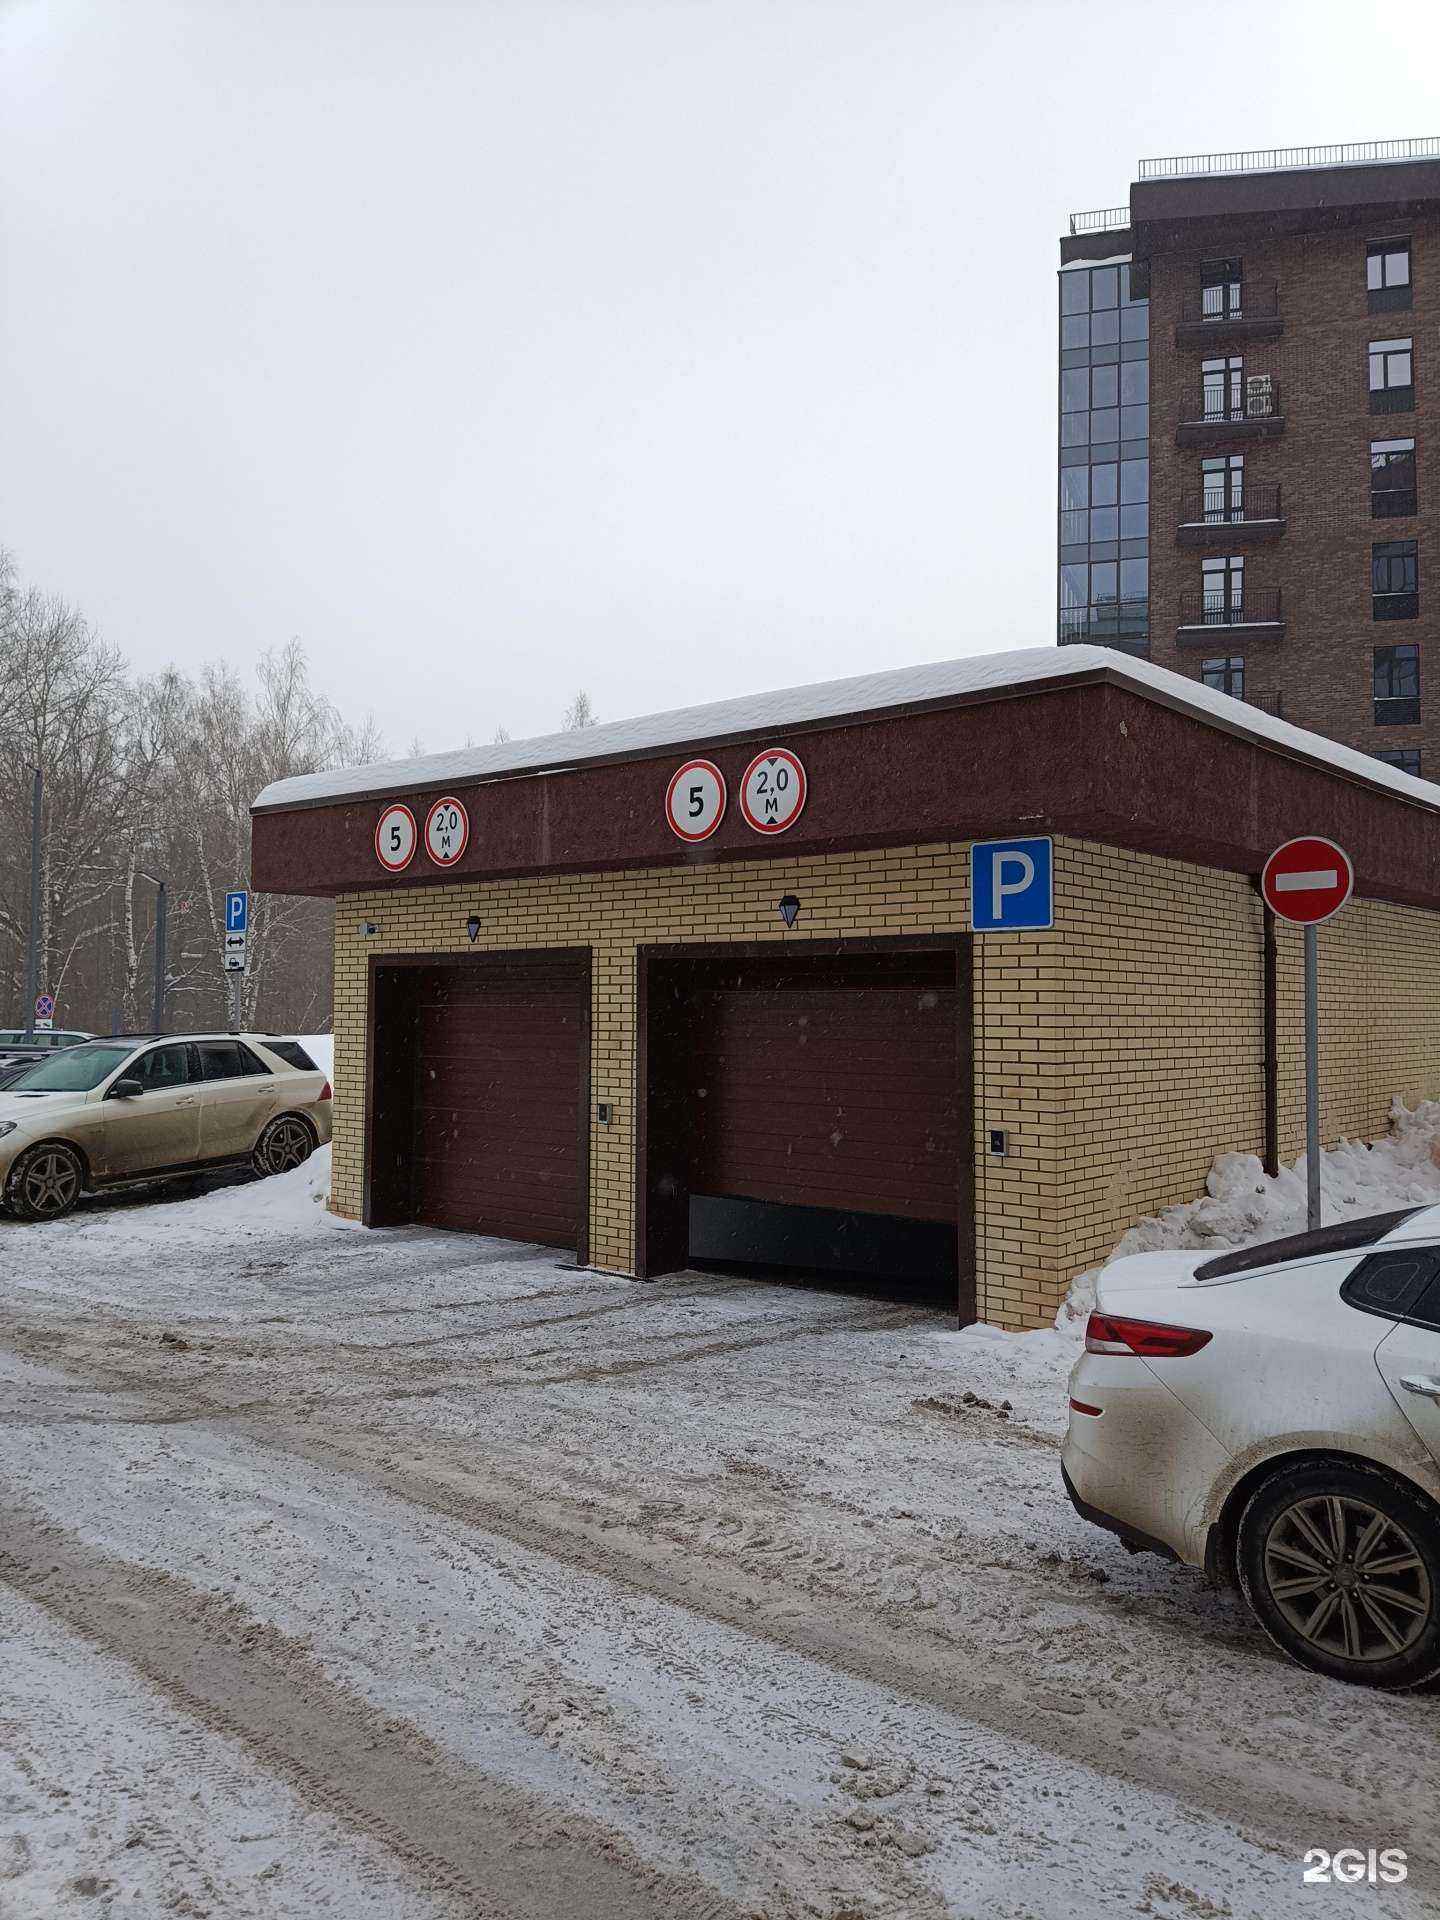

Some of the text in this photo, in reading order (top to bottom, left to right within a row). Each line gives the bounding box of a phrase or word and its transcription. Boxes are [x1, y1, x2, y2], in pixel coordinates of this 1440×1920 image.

[756, 768, 789, 796] 2,0
[688, 786, 704, 817] 5
[436, 811, 458, 833] 2,0
[390, 826, 401, 851] 5
[992, 850, 1035, 920] P
[231, 897, 243, 927] P
